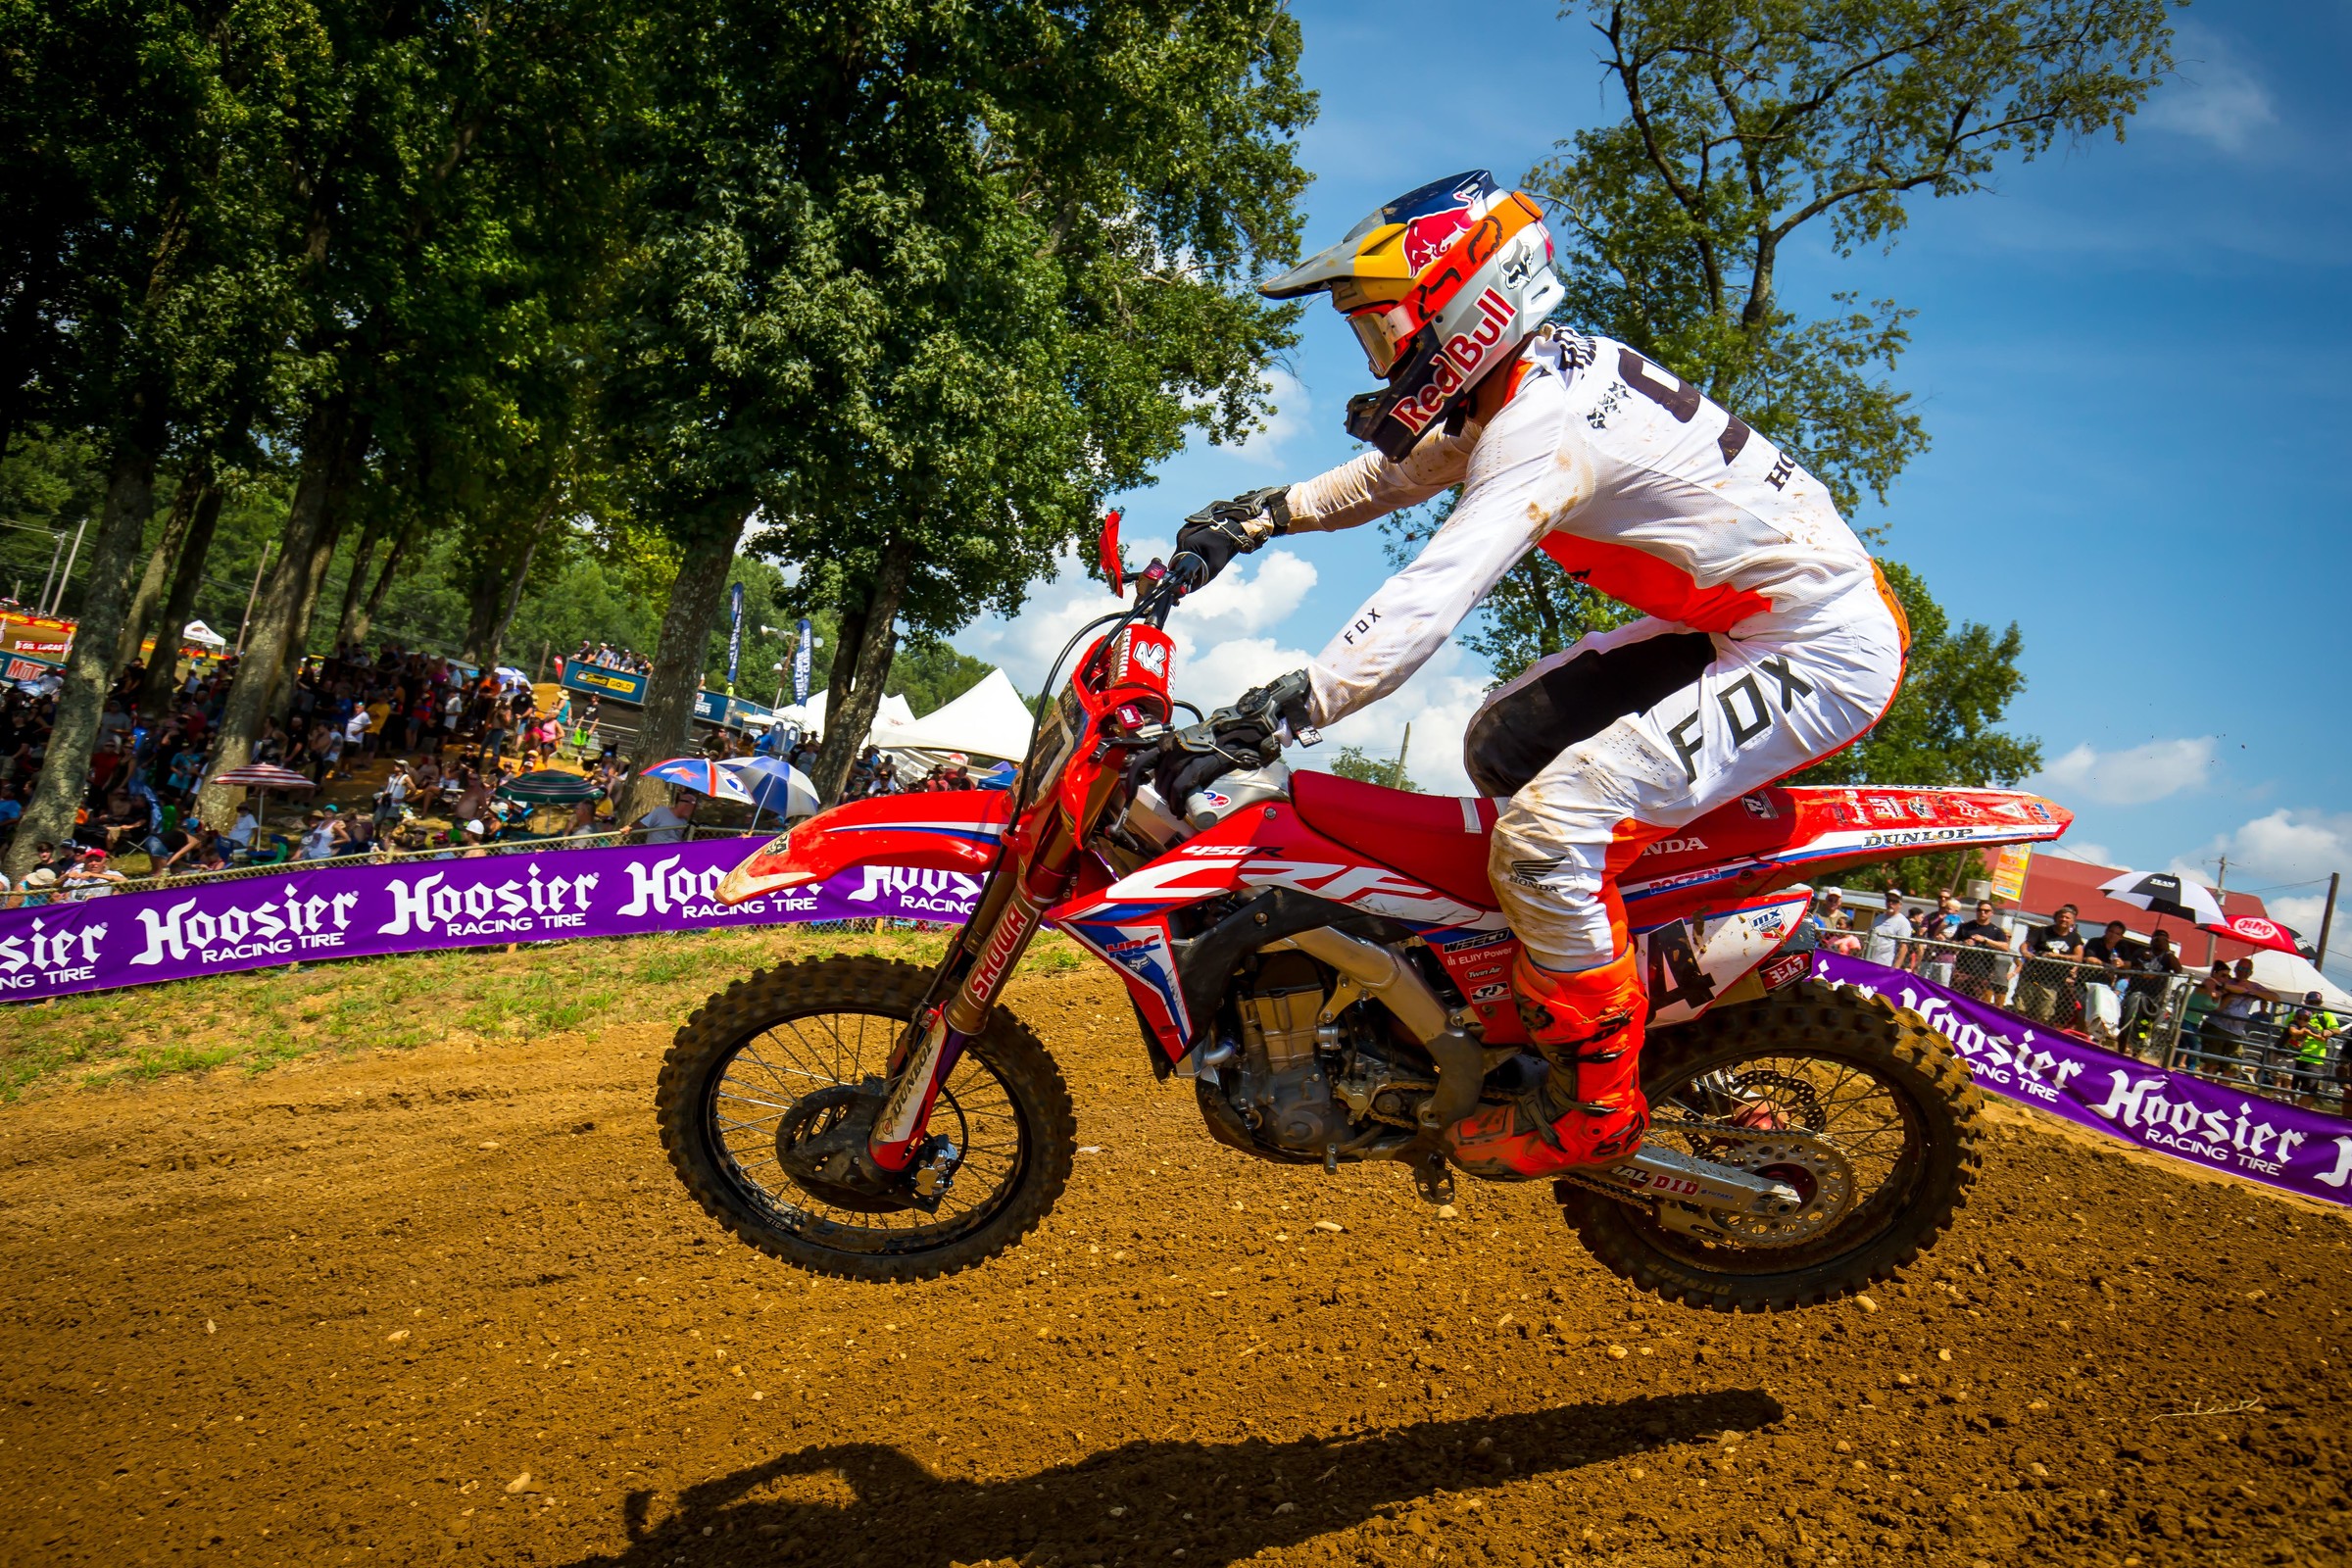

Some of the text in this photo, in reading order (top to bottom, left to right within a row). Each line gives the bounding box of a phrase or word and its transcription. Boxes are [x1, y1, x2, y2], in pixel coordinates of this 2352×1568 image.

[1389, 284, 1519, 437] Red Bull
[1344, 608, 1382, 645] FOX
[1667, 656, 1813, 784] FOX
[1181, 846, 1285, 858] 450R
[1642, 837, 1708, 857] NDA
[1864, 828, 1974, 847] DUNLOP
[1105, 858, 1433, 900] CRF
[1509, 874, 1559, 893] HONDA
[1649, 868, 1722, 896] ROCZEN
[377, 862, 599, 936] Hoosier
[683, 898, 817, 919] RACING TIRE
[900, 895, 977, 915] RACING
[129, 883, 359, 965] Hoosier
[447, 912, 586, 937] RACING TIRE
[0, 917, 108, 974] sier
[202, 932, 345, 964] RACING TIRE
[969, 901, 1029, 1002] SHOWA
[1106, 934, 1161, 958] HRC
[1485, 947, 1513, 959] Power
[43, 965, 96, 984] TIRE
[1468, 965, 1501, 978] Twin Air
[1647, 918, 1717, 1010] 4
[894, 1032, 933, 1119] DUNLOP
[1965, 1058, 2059, 1103] CING TIRE
[2085, 1069, 2305, 1164] Hoosier
[2145, 1128, 2229, 1161] RACING
[2236, 1152, 2282, 1176] TIRE
